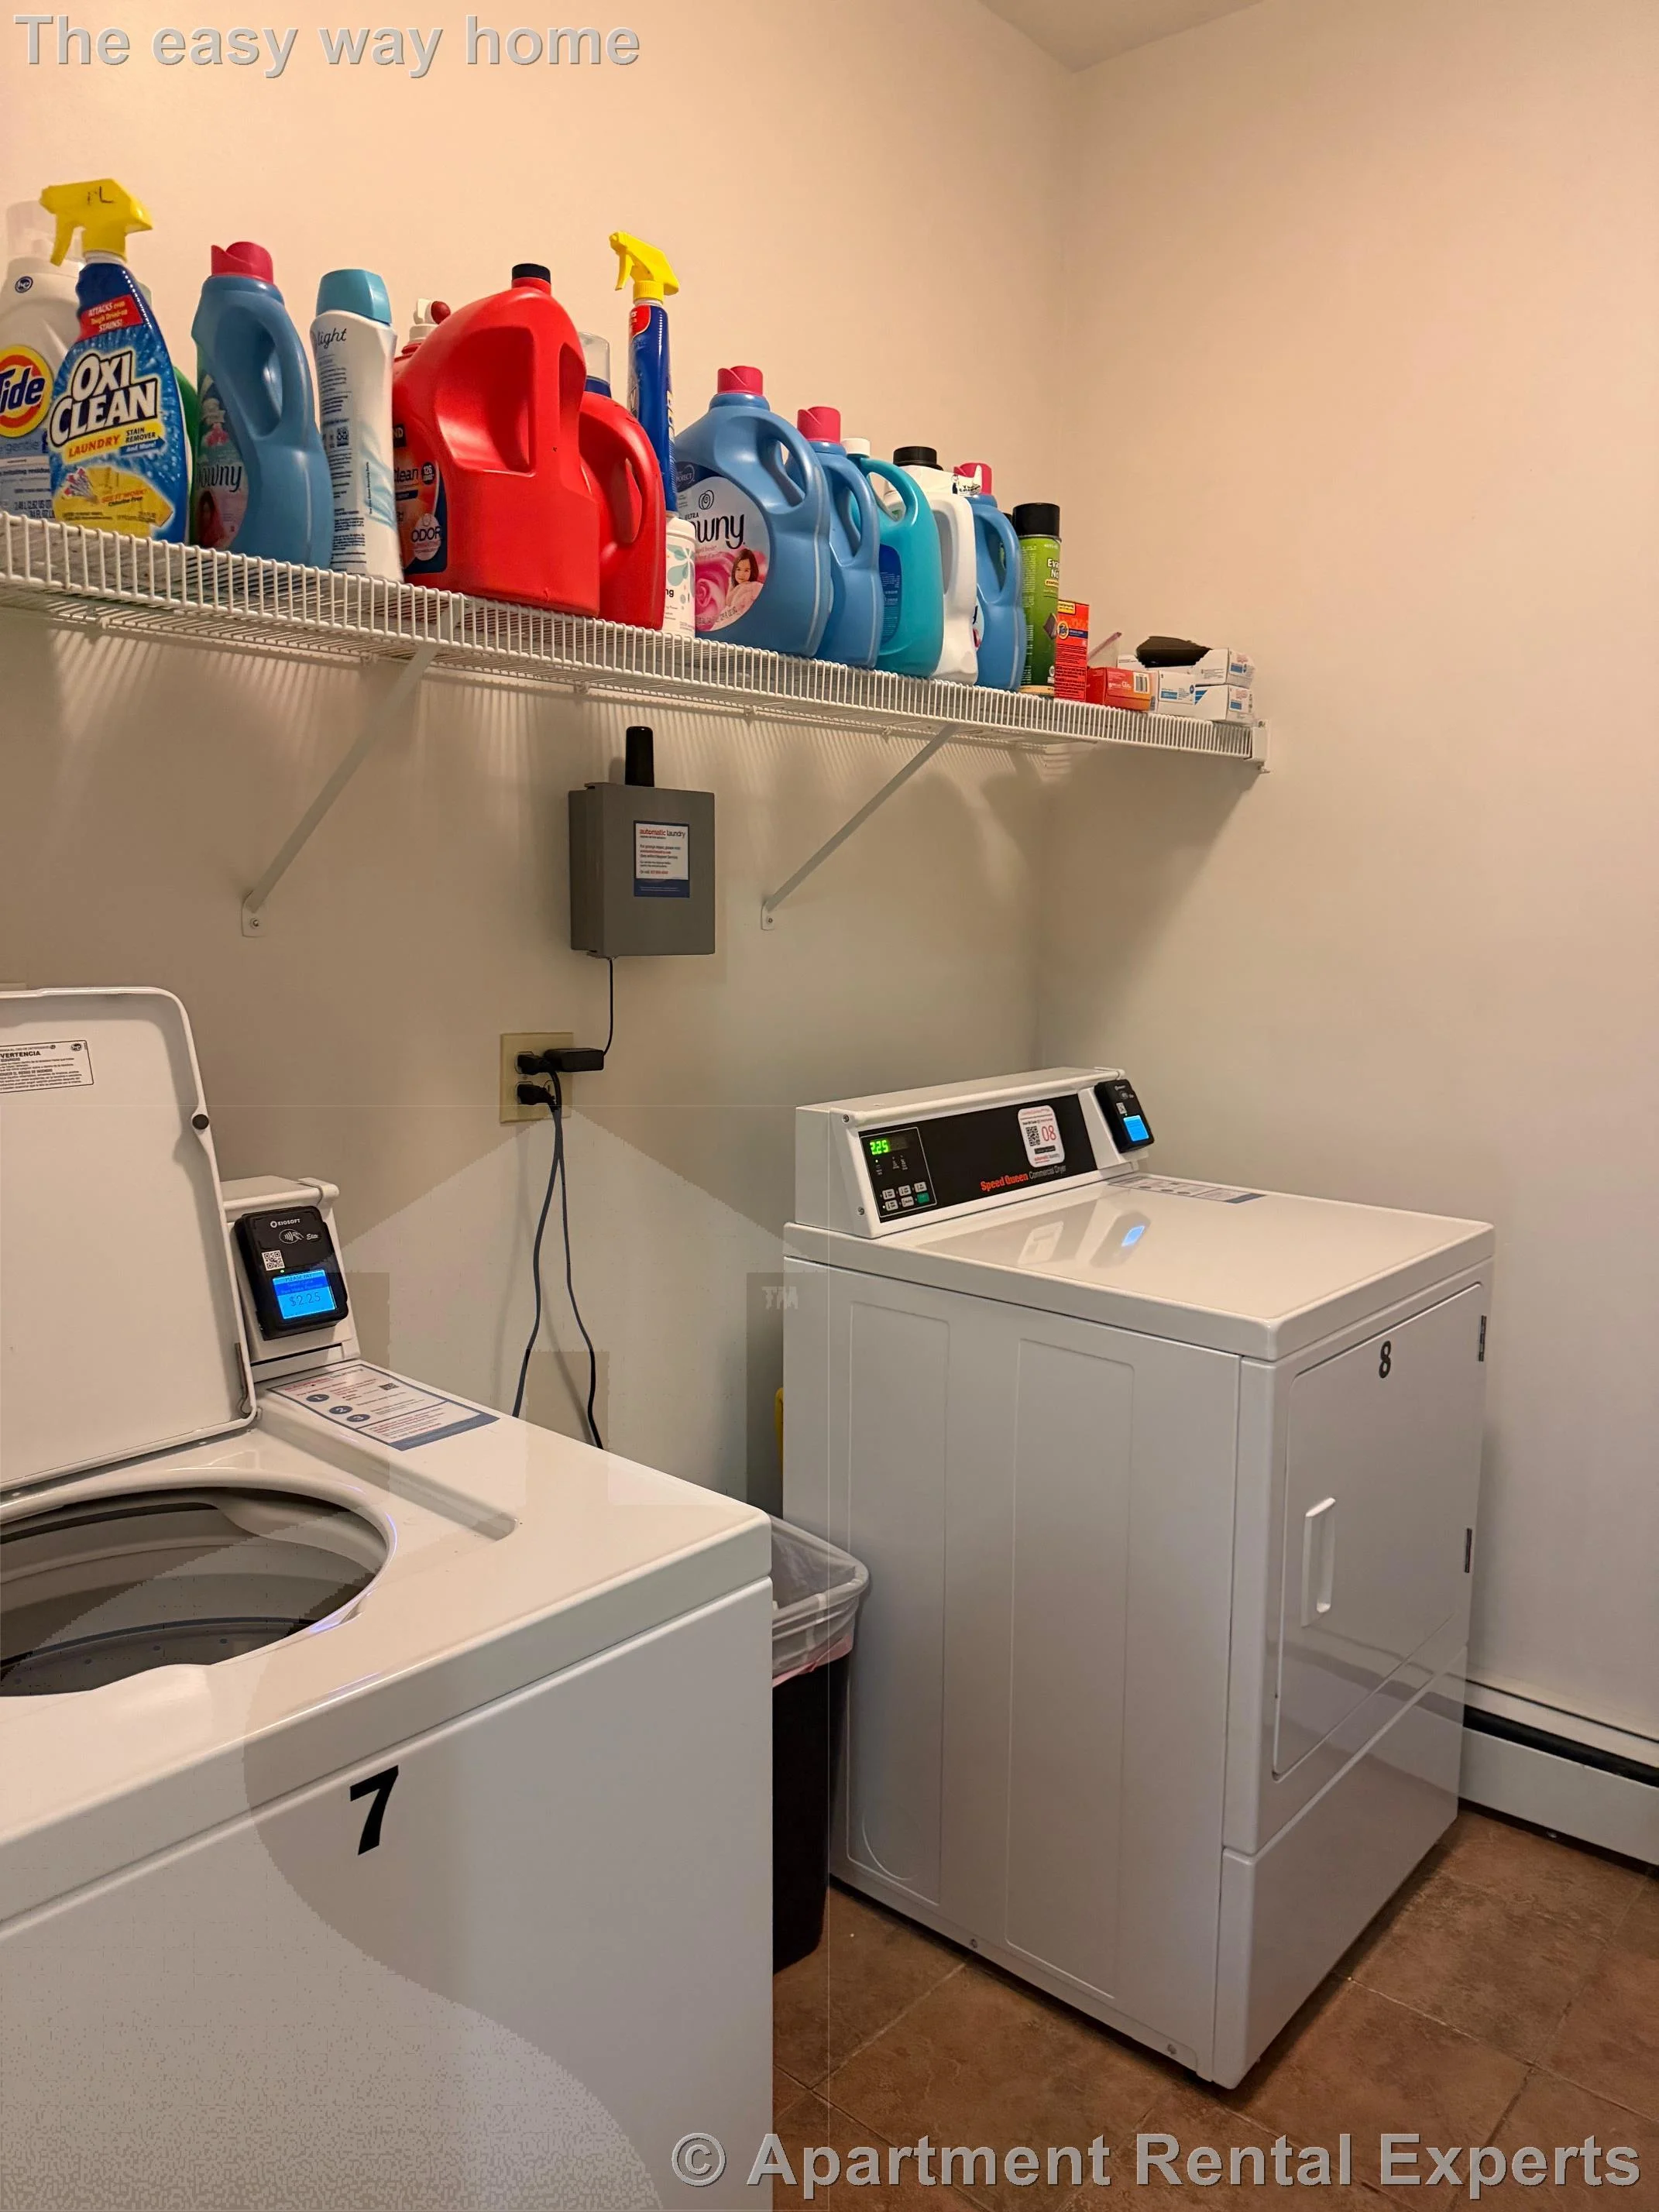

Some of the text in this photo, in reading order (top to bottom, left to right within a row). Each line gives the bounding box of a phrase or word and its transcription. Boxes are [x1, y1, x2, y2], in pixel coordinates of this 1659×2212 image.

[71, 351, 132, 402] OXI
[50, 378, 157, 448] CLEAN
[125, 431, 156, 443] REMOVER
[126, 428, 145, 437] STAIN
[68, 434, 121, 458] LAUNDRY
[639, 828, 686, 839] automatic laundry
[1042, 1125, 1056, 1142] 08
[980, 1165, 1066, 1191] Speed Queen Commercial Dryer
[1379, 1340, 1391, 1379] 8
[349, 1764, 399, 1856] 7
